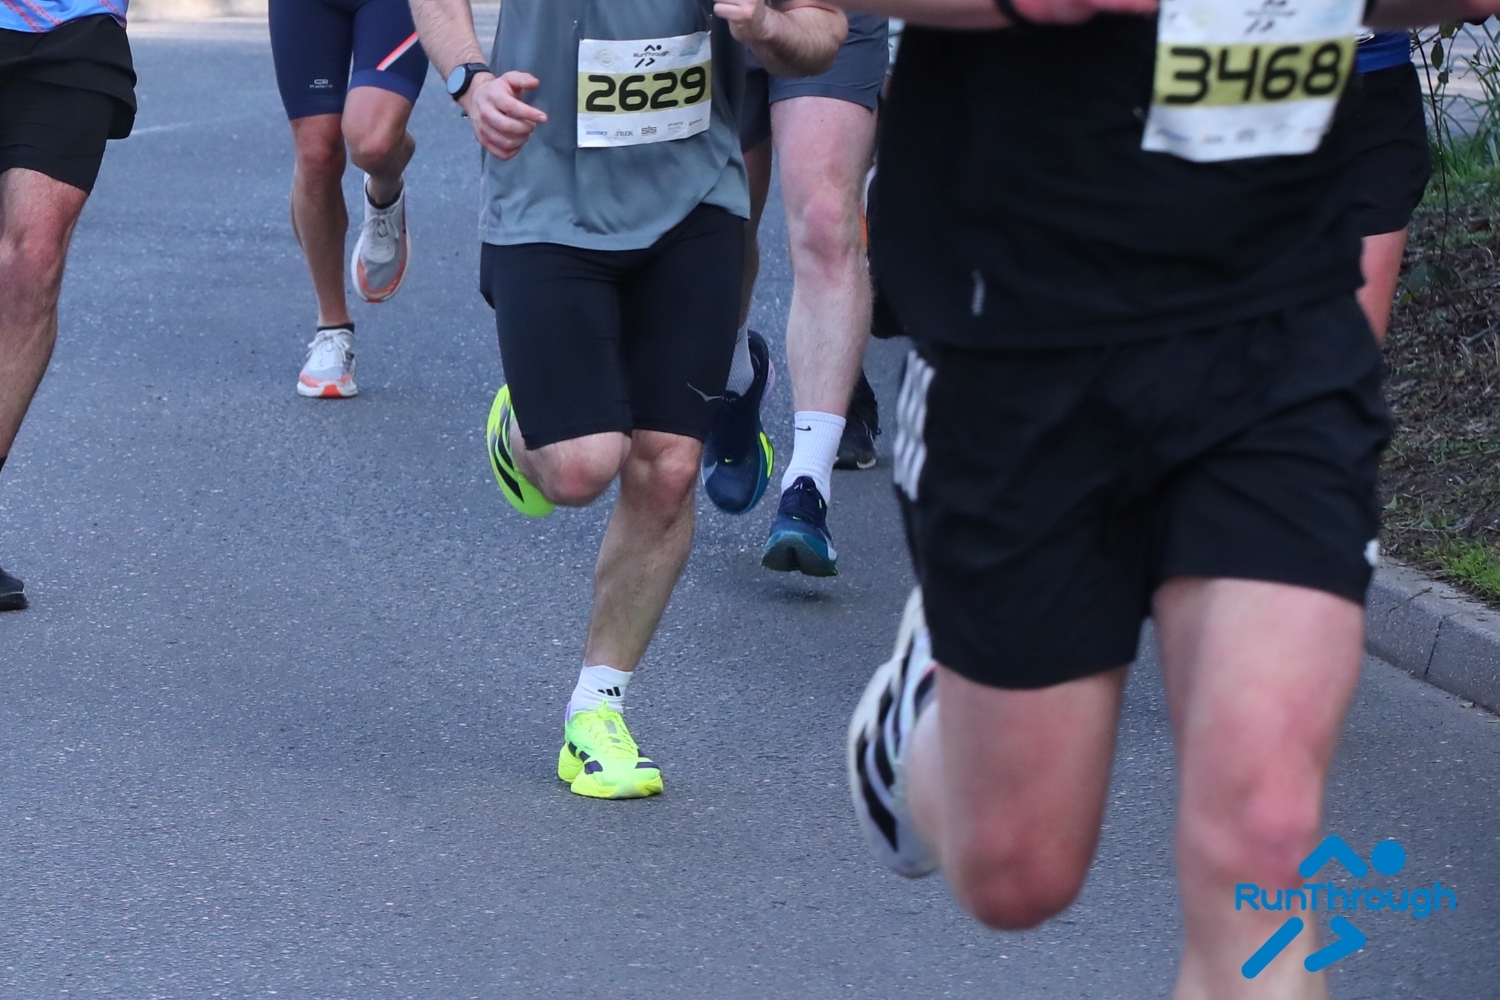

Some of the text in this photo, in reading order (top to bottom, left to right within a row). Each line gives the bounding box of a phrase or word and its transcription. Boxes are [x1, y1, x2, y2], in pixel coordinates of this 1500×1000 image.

[633, 50, 670, 58] RunThrough
[1164, 41, 1342, 105] 3468
[585, 65, 706, 112] 2629
